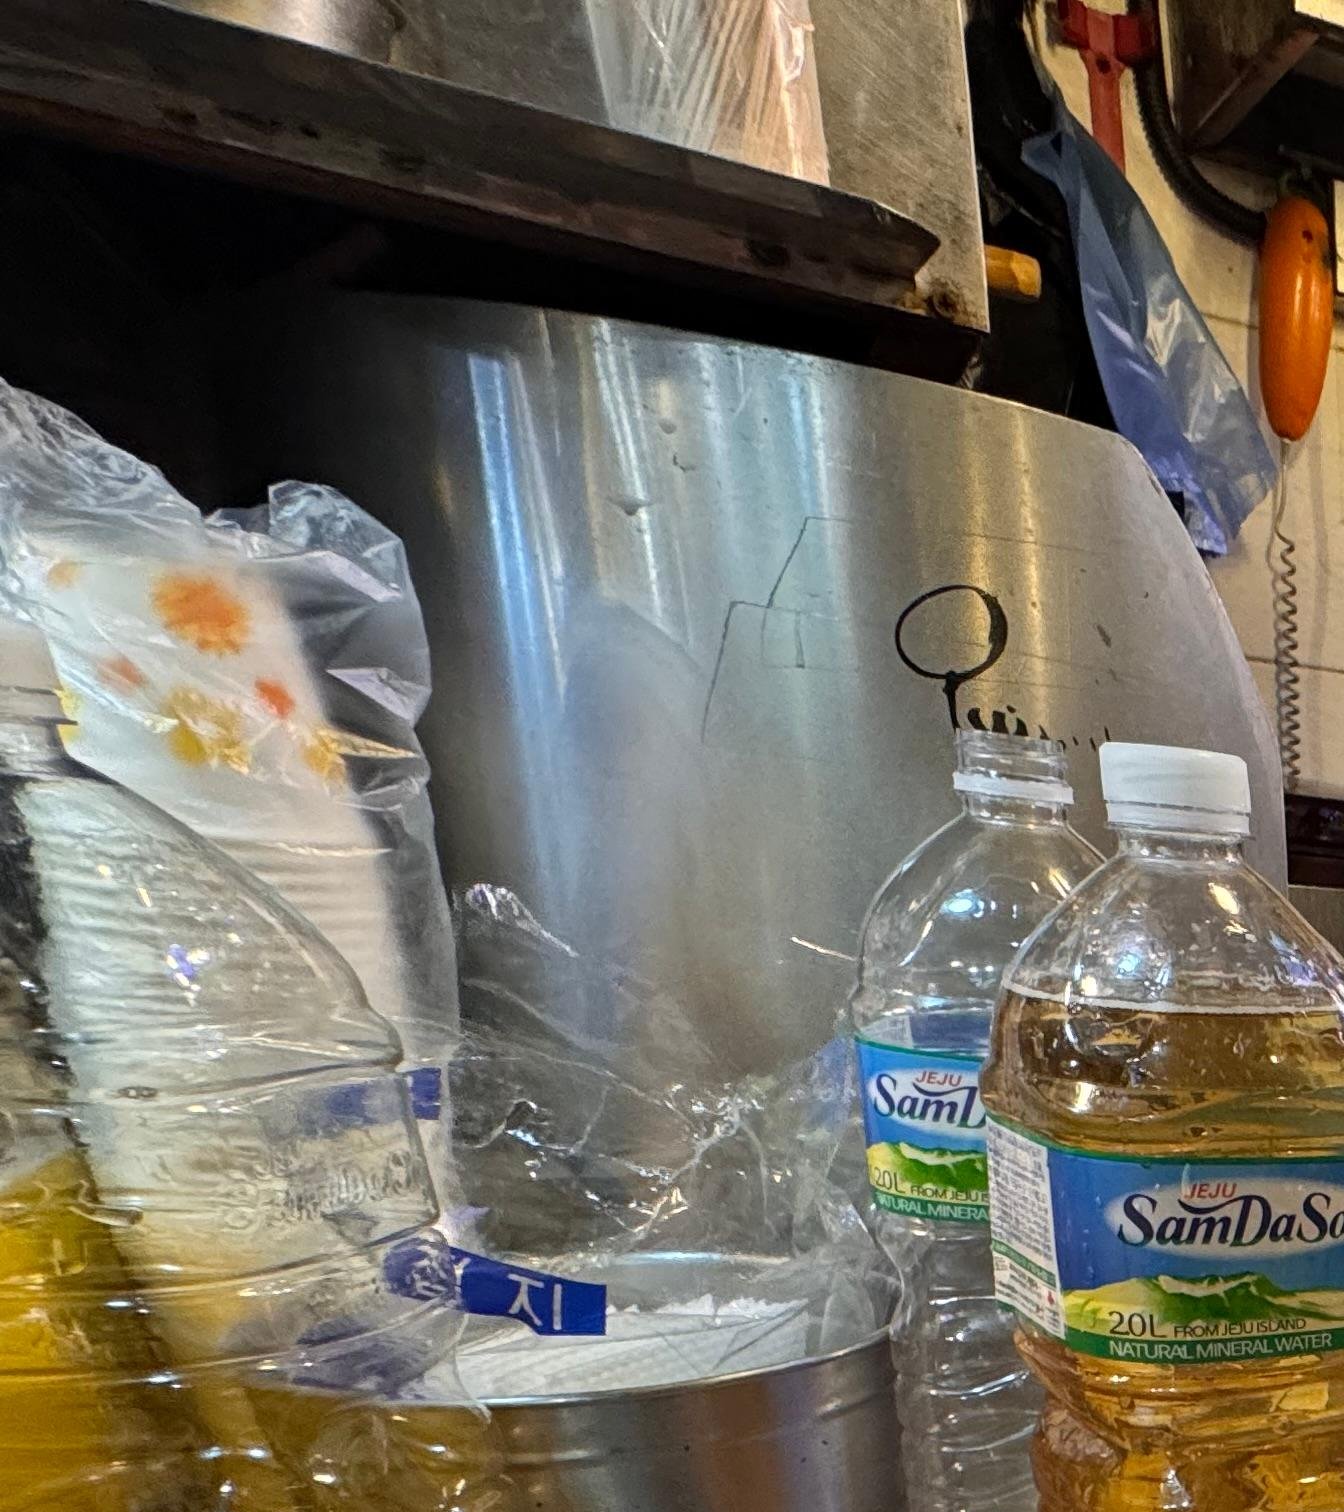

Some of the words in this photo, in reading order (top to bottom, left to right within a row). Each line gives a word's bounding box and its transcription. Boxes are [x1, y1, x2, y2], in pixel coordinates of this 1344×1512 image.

[915, 1070, 962, 1087] JEJU
[910, 1184, 948, 1199] FROM
[948, 1187, 979, 1202] JEJU
[1185, 1182, 1237, 1200] JEJU
[1173, 1324, 1220, 1339] FROM
[1221, 1321, 1254, 1336] JEJU
[1256, 1317, 1307, 1333] ISLAND
[1108, 1339, 1194, 1361] NATURAL
[1196, 1337, 1273, 1358] MINERAL
[1273, 1332, 1333, 1353] WATER
